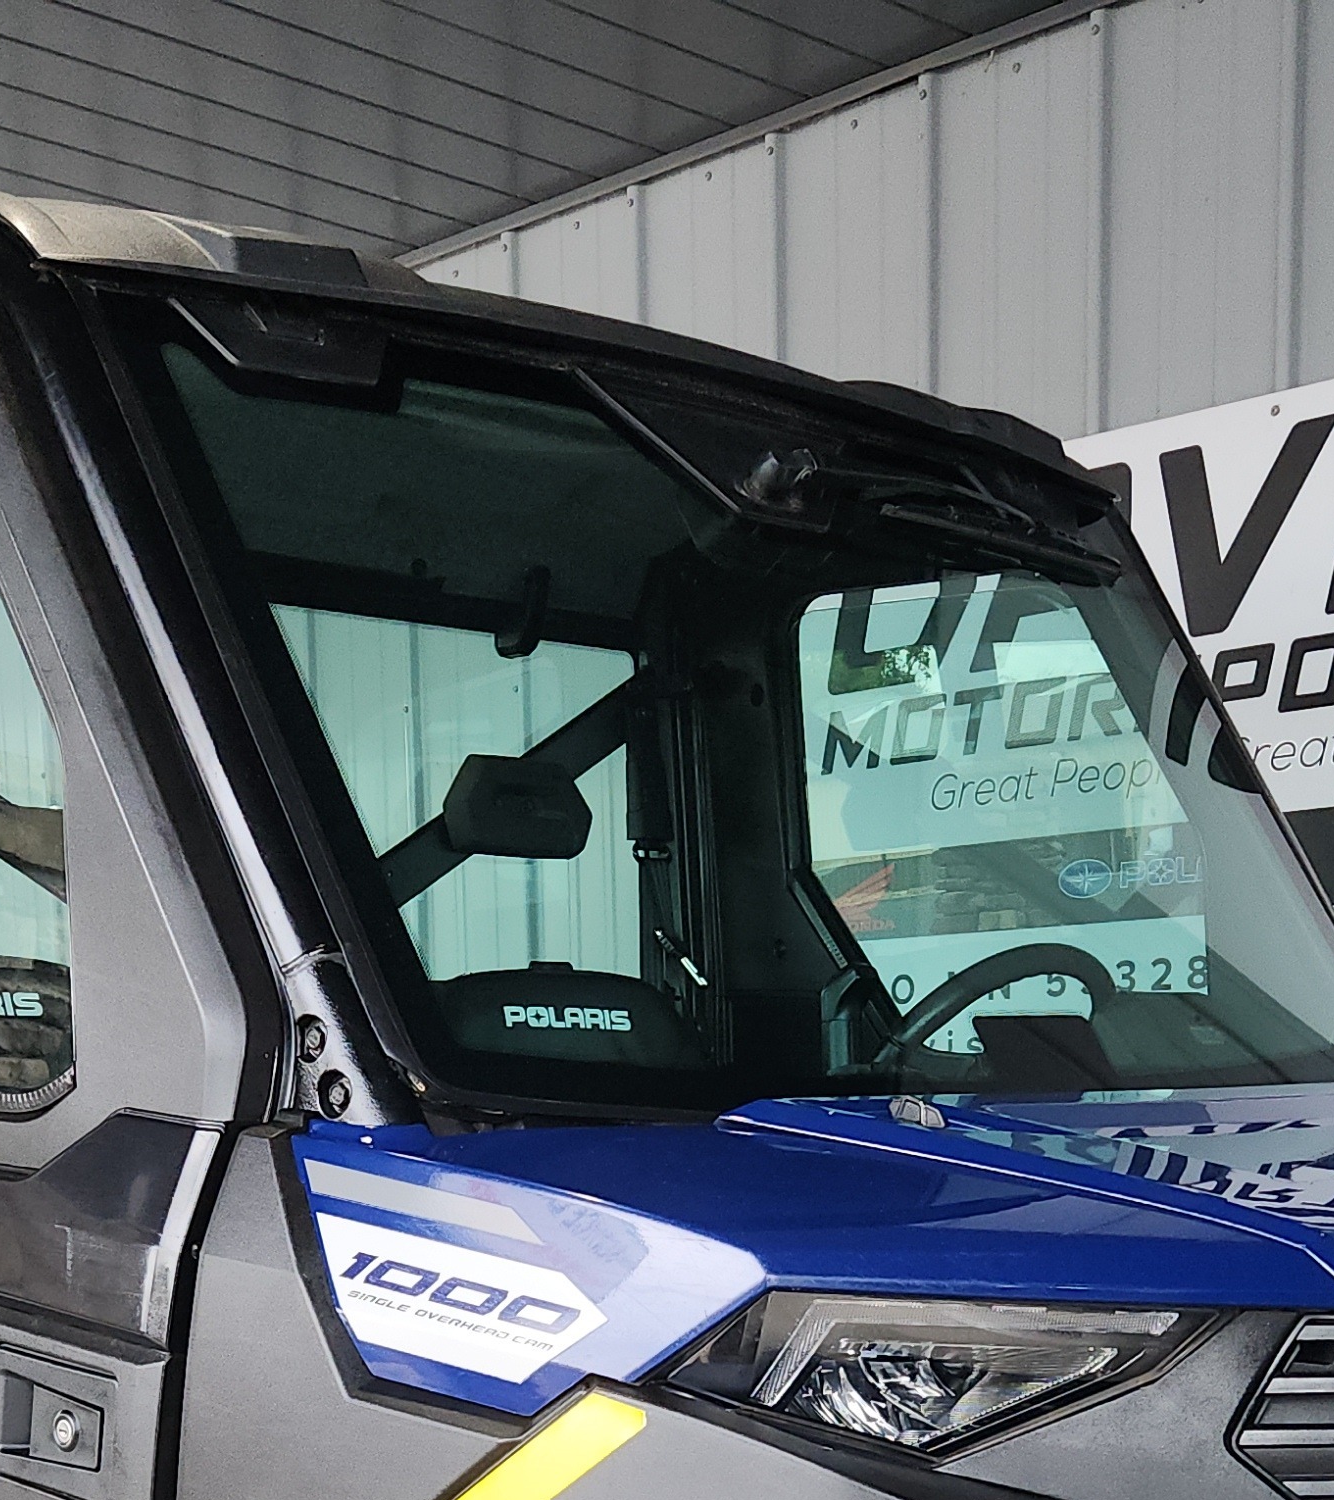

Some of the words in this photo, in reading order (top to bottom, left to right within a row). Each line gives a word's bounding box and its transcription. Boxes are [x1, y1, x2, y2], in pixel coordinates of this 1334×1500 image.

[931, 765, 1035, 812] Great
[502, 1005, 632, 1032] POLARIS
[339, 1251, 581, 1336] 1000
[348, 1289, 411, 1314] SINGLE
[415, 1308, 510, 1341] OVERHEAD
[513, 1333, 554, 1353] CAM
